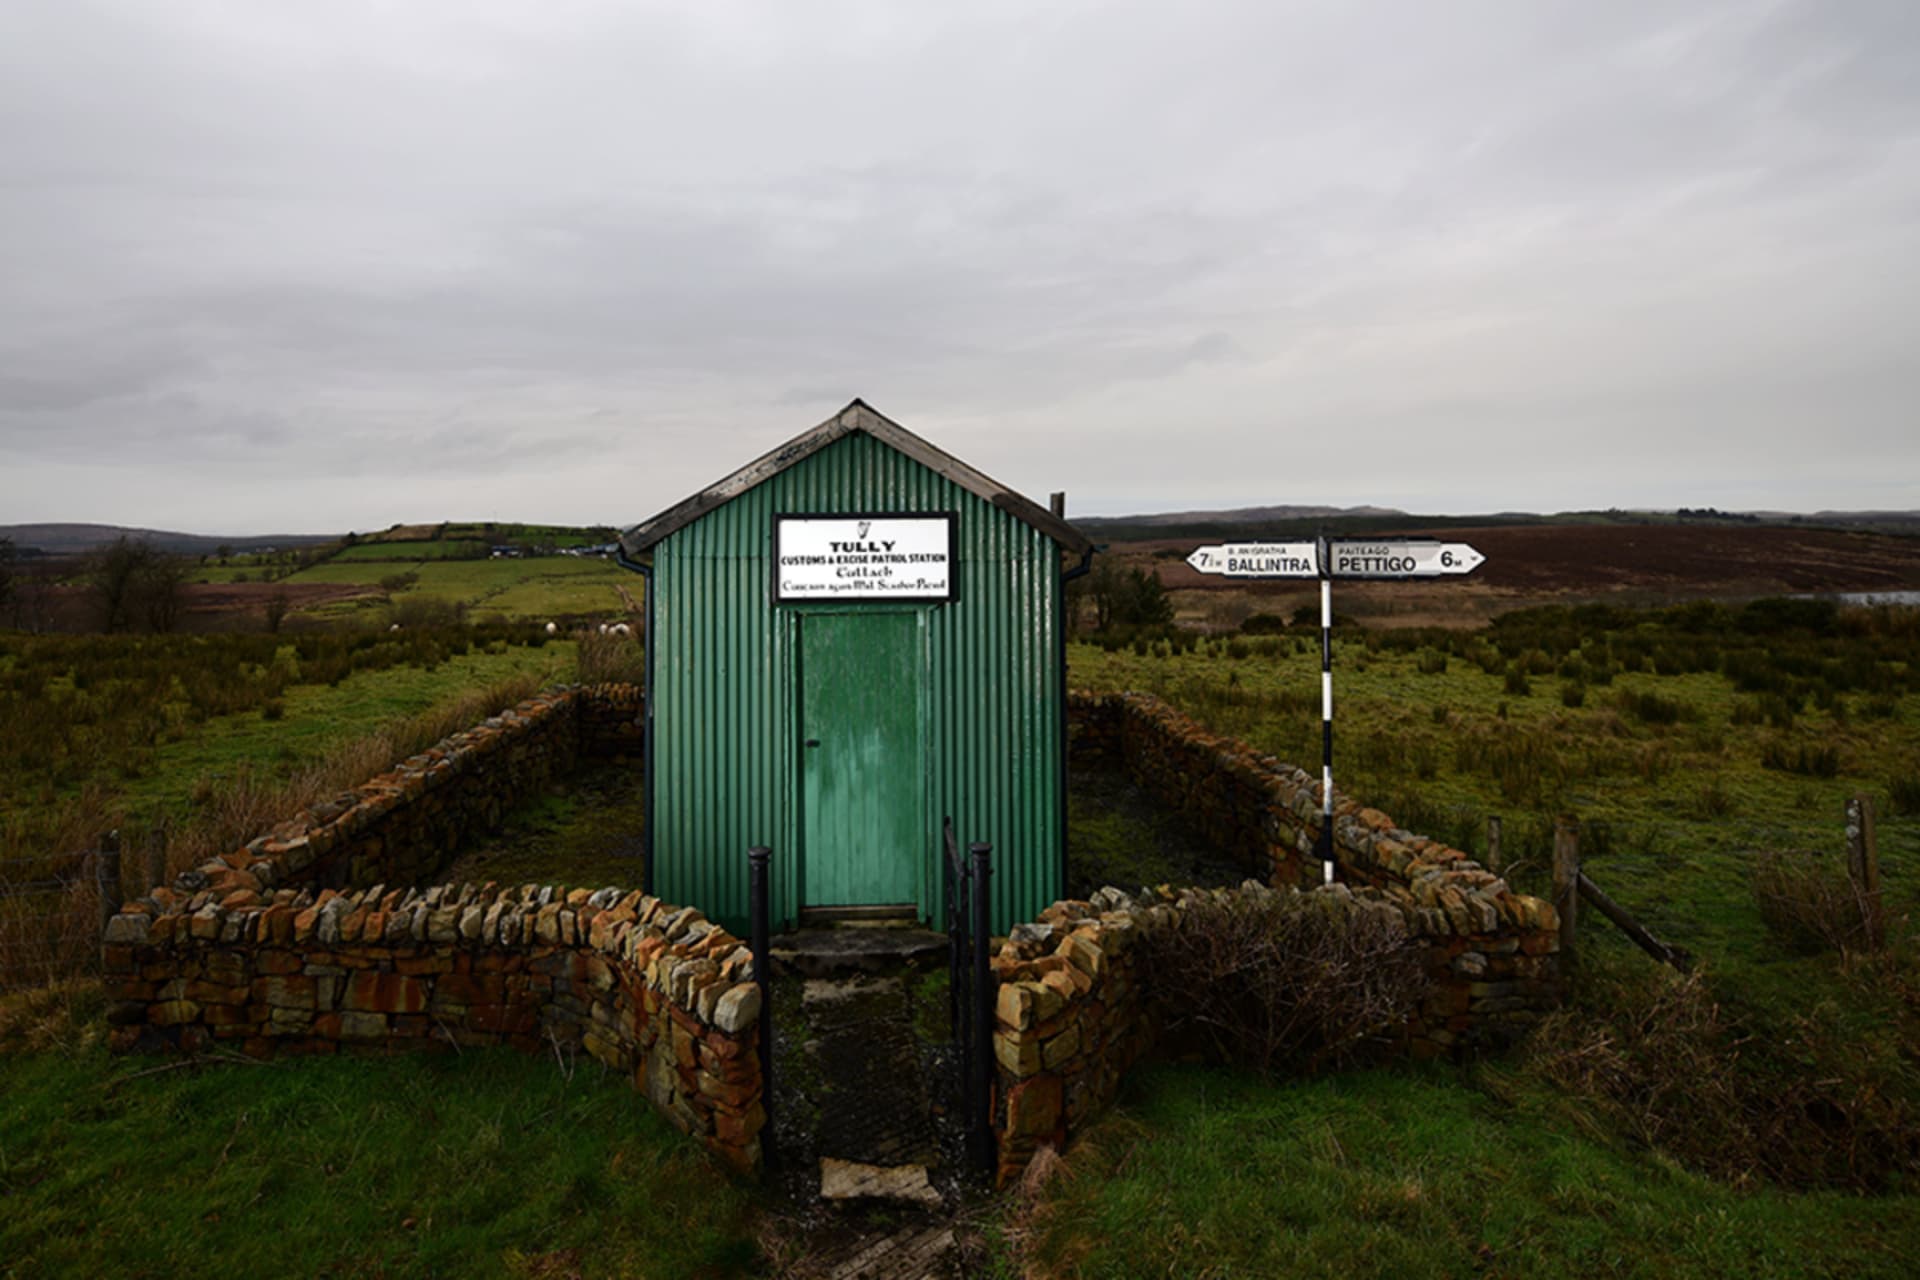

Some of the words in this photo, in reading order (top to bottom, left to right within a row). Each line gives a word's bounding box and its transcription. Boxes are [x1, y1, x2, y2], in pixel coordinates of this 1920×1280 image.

[829, 541, 896, 553] TULLY
[781, 555, 826, 566] CUSTOMS
[828, 556, 834, 565] &
[836, 555, 868, 565] EXCISE
[871, 554, 908, 564] PATROL
[909, 553, 946, 563] STATION
[1228, 558, 1312, 572] BALLINTRA
[1338, 556, 1417, 572] PETTIGO
[1440, 550, 1453, 568] 6
